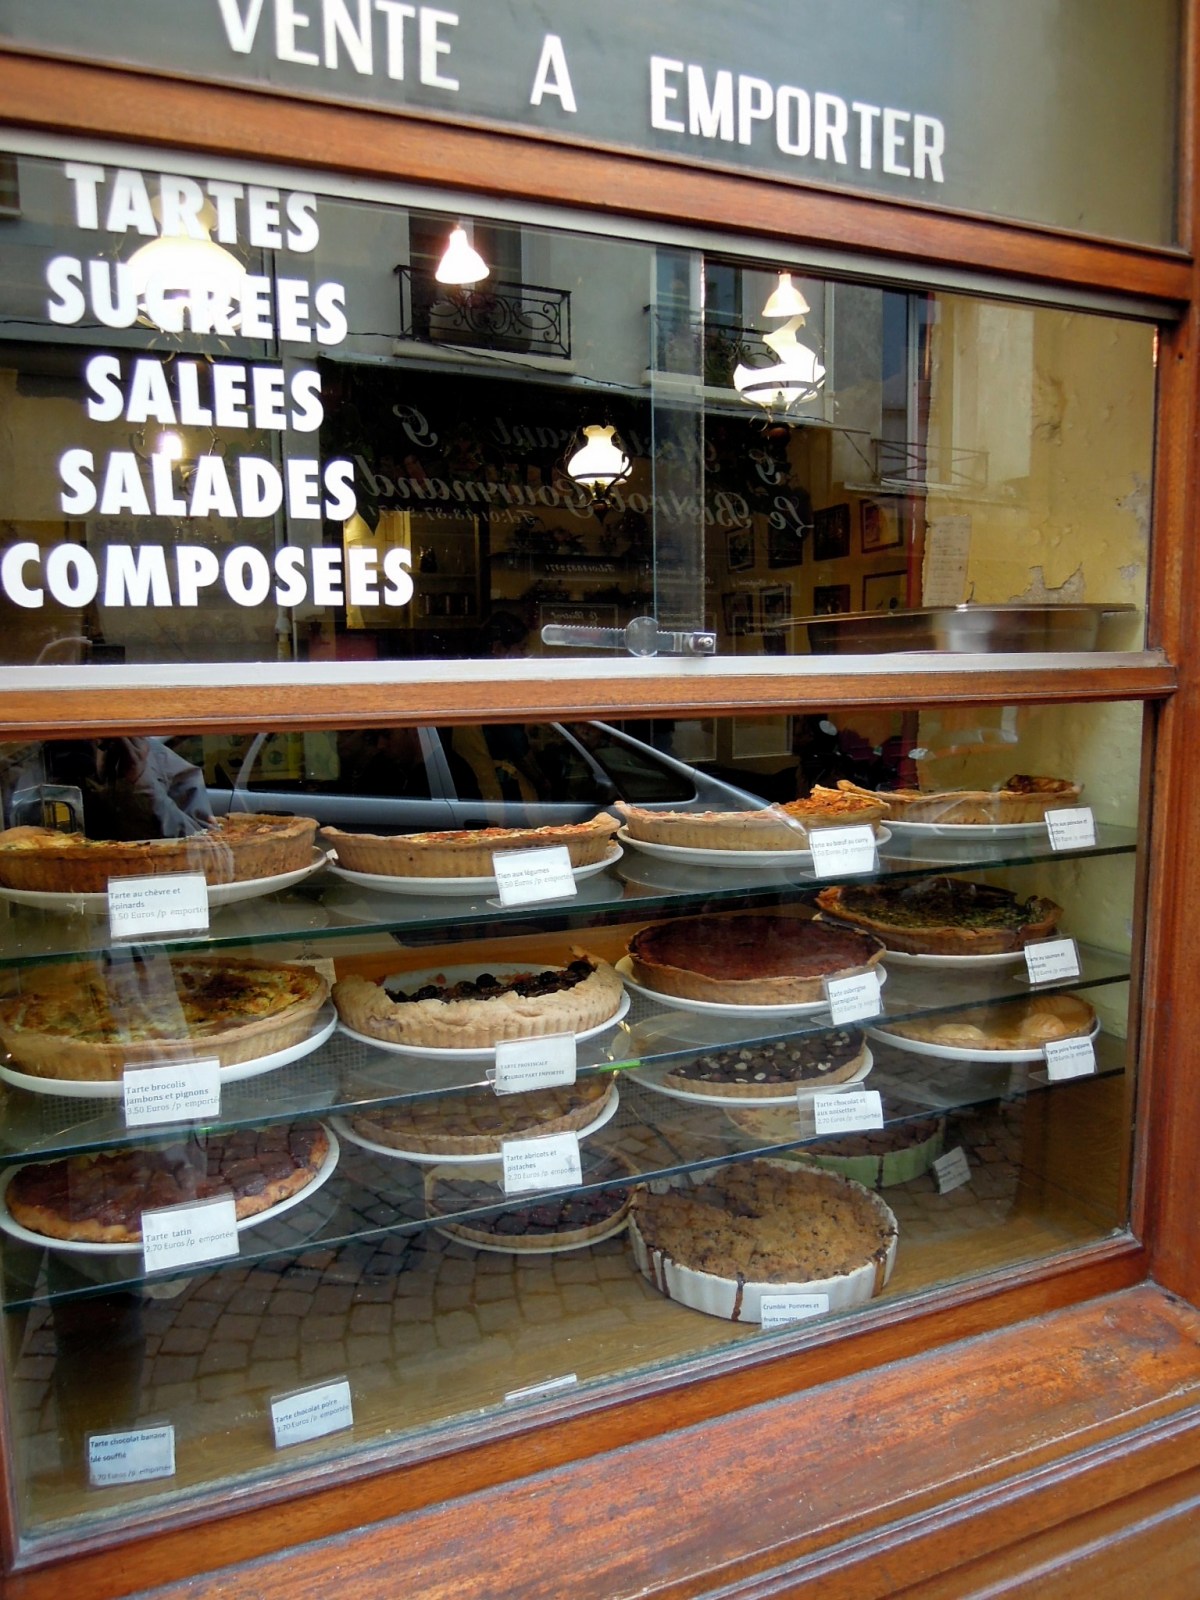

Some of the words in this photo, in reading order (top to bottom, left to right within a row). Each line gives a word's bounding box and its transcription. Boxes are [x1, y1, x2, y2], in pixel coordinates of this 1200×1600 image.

[219, 0, 461, 92] VENTE
[529, 34, 578, 113] A
[649, 55, 946, 184] EMPORTER
[64, 162, 320, 254] TARTES
[46, 256, 349, 347] SUCREES
[85, 355, 325, 434] SALEES
[59, 448, 357, 522] SALADES
[0, 540, 415, 609] COMPOSEES
[524, 867, 550, 877] légumes
[514, 879, 533, 887] Euros
[144, 888, 171, 897] chèvre
[110, 900, 145, 911] épinards
[131, 911, 155, 919] Euros
[126, 1086, 150, 1095] Tarte
[151, 1080, 186, 1091] brocolis
[126, 1094, 164, 1106] jambons
[164, 1092, 174, 1100] et
[175, 1088, 209, 1100] pignons
[833, 1098, 859, 1106] chocolat
[127, 1106, 145, 1116] 3.50
[146, 1104, 170, 1113] Euros
[828, 1107, 857, 1115] noisettes
[506, 1154, 523, 1162] Tarte
[524, 1151, 550, 1160] abricots
[507, 1162, 537, 1173] pistaches
[146, 1233, 169, 1242] Tarte
[172, 1228, 192, 1238] tatin
[146, 1243, 163, 1253] 2.70
[164, 1240, 185, 1250] Euros
[199, 1231, 234, 1244] emportée
[275, 1413, 293, 1423] Tarte
[293, 1404, 321, 1418] chocolat
[321, 1399, 338, 1410] poire
[277, 1423, 291, 1433] 2.70
[291, 1418, 310, 1428] Euros
[91, 1440, 109, 1448] Tarte
[110, 1435, 140, 1446] chocolat
[140, 1432, 167, 1441] banane
[102, 1451, 127, 1461] soufflé
